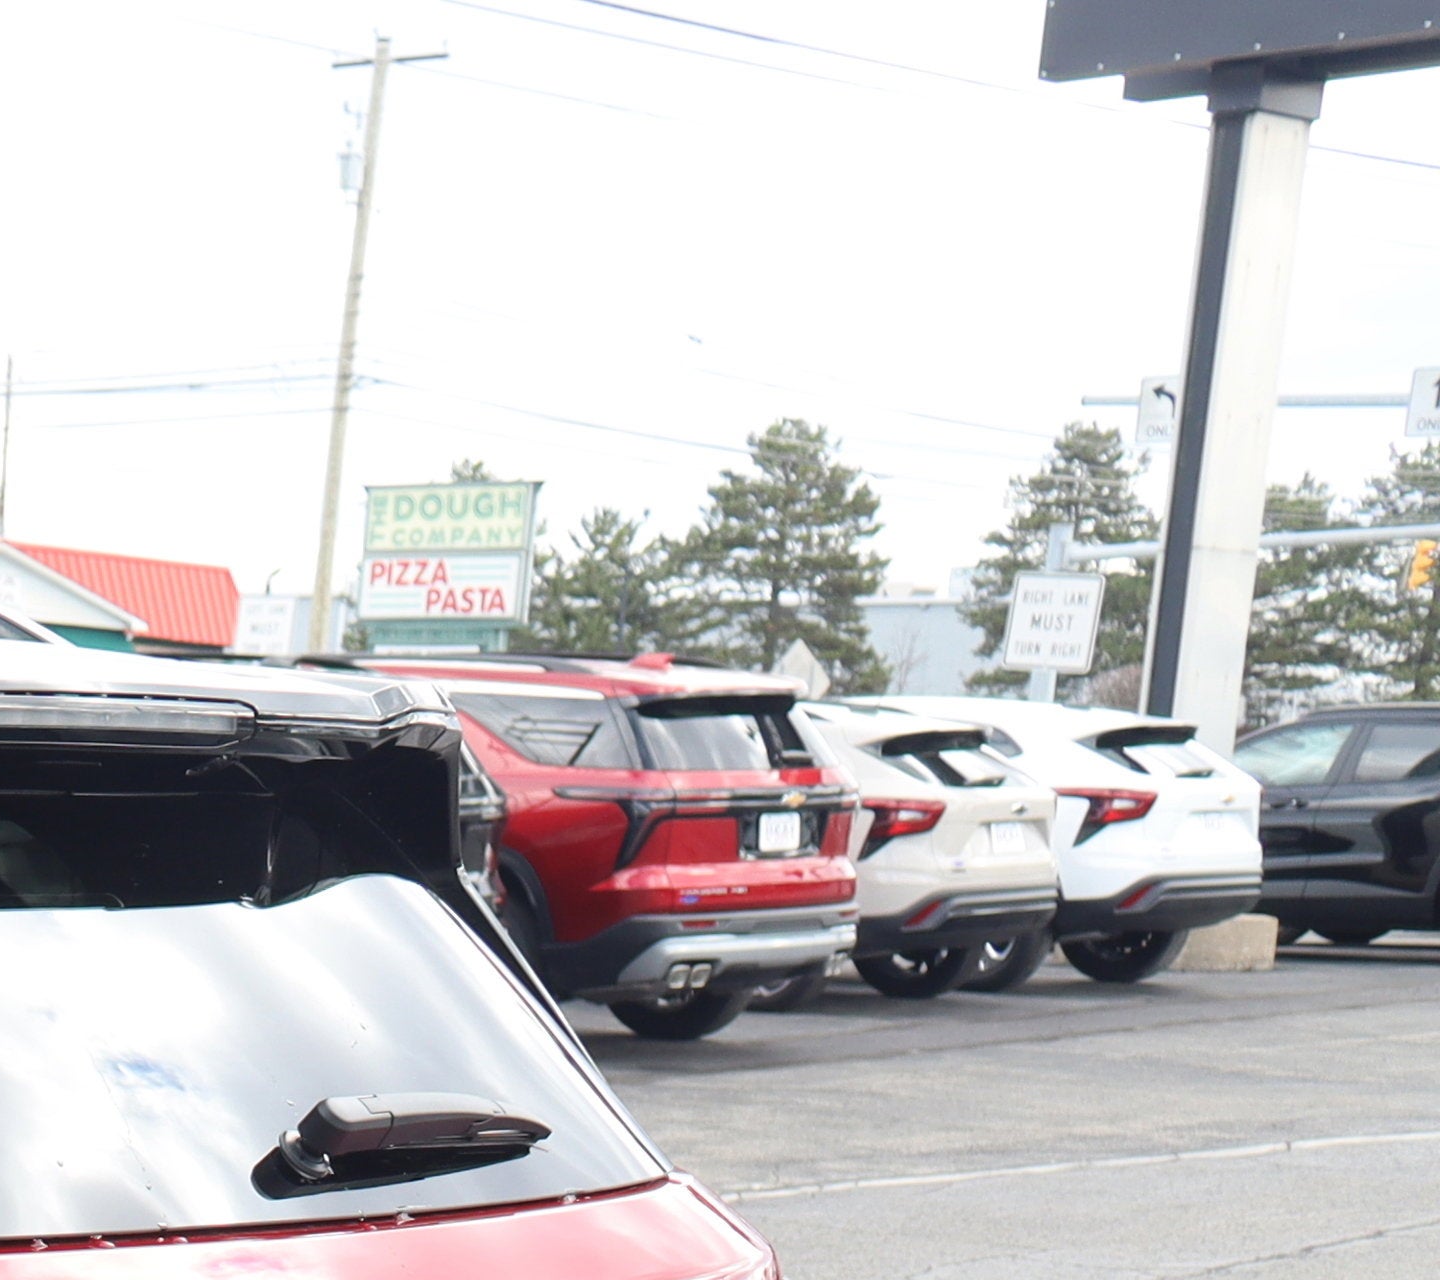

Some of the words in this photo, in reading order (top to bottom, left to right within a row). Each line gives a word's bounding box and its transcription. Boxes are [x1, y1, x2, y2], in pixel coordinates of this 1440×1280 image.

[394, 491, 522, 521] DOUGH
[370, 496, 388, 545] THE
[392, 526, 522, 546] COMPANY
[370, 558, 448, 586] PIZZA
[425, 587, 506, 614] PASTA
[1030, 612, 1074, 631] MUST
